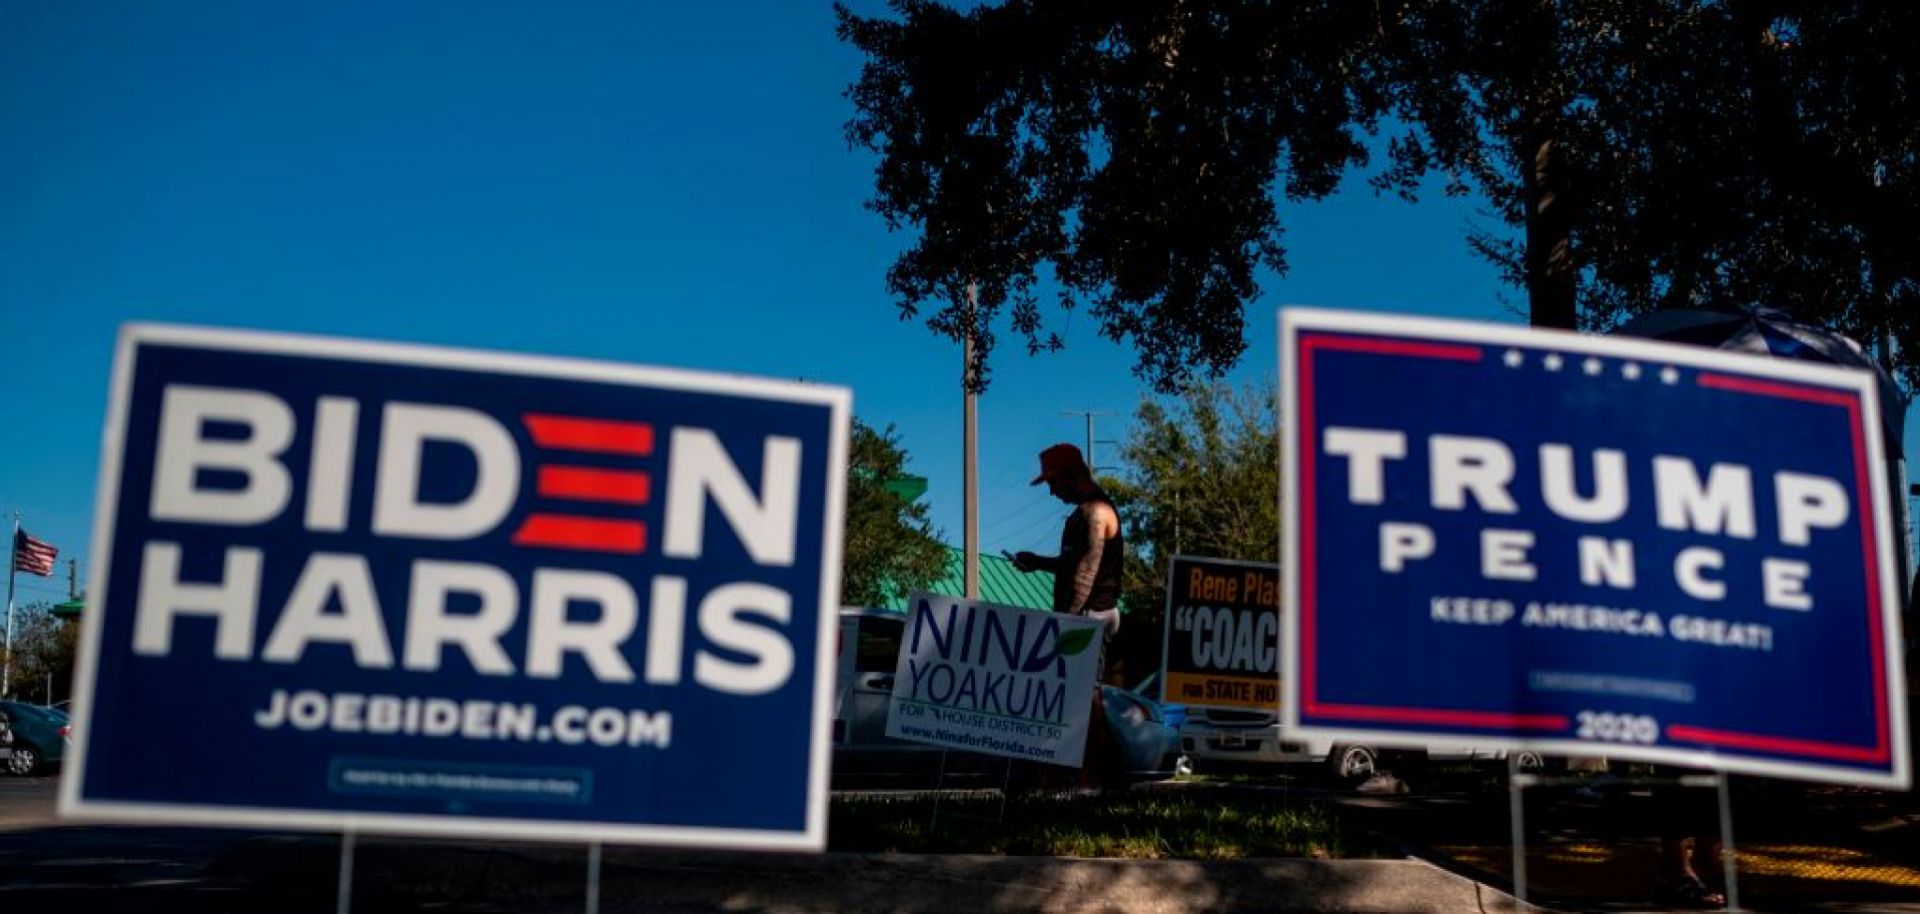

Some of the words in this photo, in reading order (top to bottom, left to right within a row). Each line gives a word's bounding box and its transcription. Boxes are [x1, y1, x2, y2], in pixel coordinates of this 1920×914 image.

[149, 384, 804, 567] BIDEN
[1323, 426, 1851, 547] TRUMP
[1189, 566, 1238, 602] Rene
[1379, 522, 1815, 611] PENCE
[131, 541, 796, 696] HARRIS
[910, 598, 1066, 678] NINA
[1175, 605, 1281, 673] “COAC
[1431, 595, 1515, 625] KEEP
[1522, 602, 1664, 637] AMERICA
[1670, 615, 1774, 651] GREAT!
[254, 689, 673, 749] JOEBIDEN.COM
[900, 703, 924, 717] FOR
[942, 712, 986, 728] HOUSE
[988, 718, 1042, 737] DISTRICT
[909, 659, 1066, 723] YOAKUM
[1205, 680, 1251, 700] STATE
[1254, 683, 1279, 702] HO
[901, 725, 1055, 759] www.NinaforFlorida.com
[1576, 711, 1660, 744] 2020
